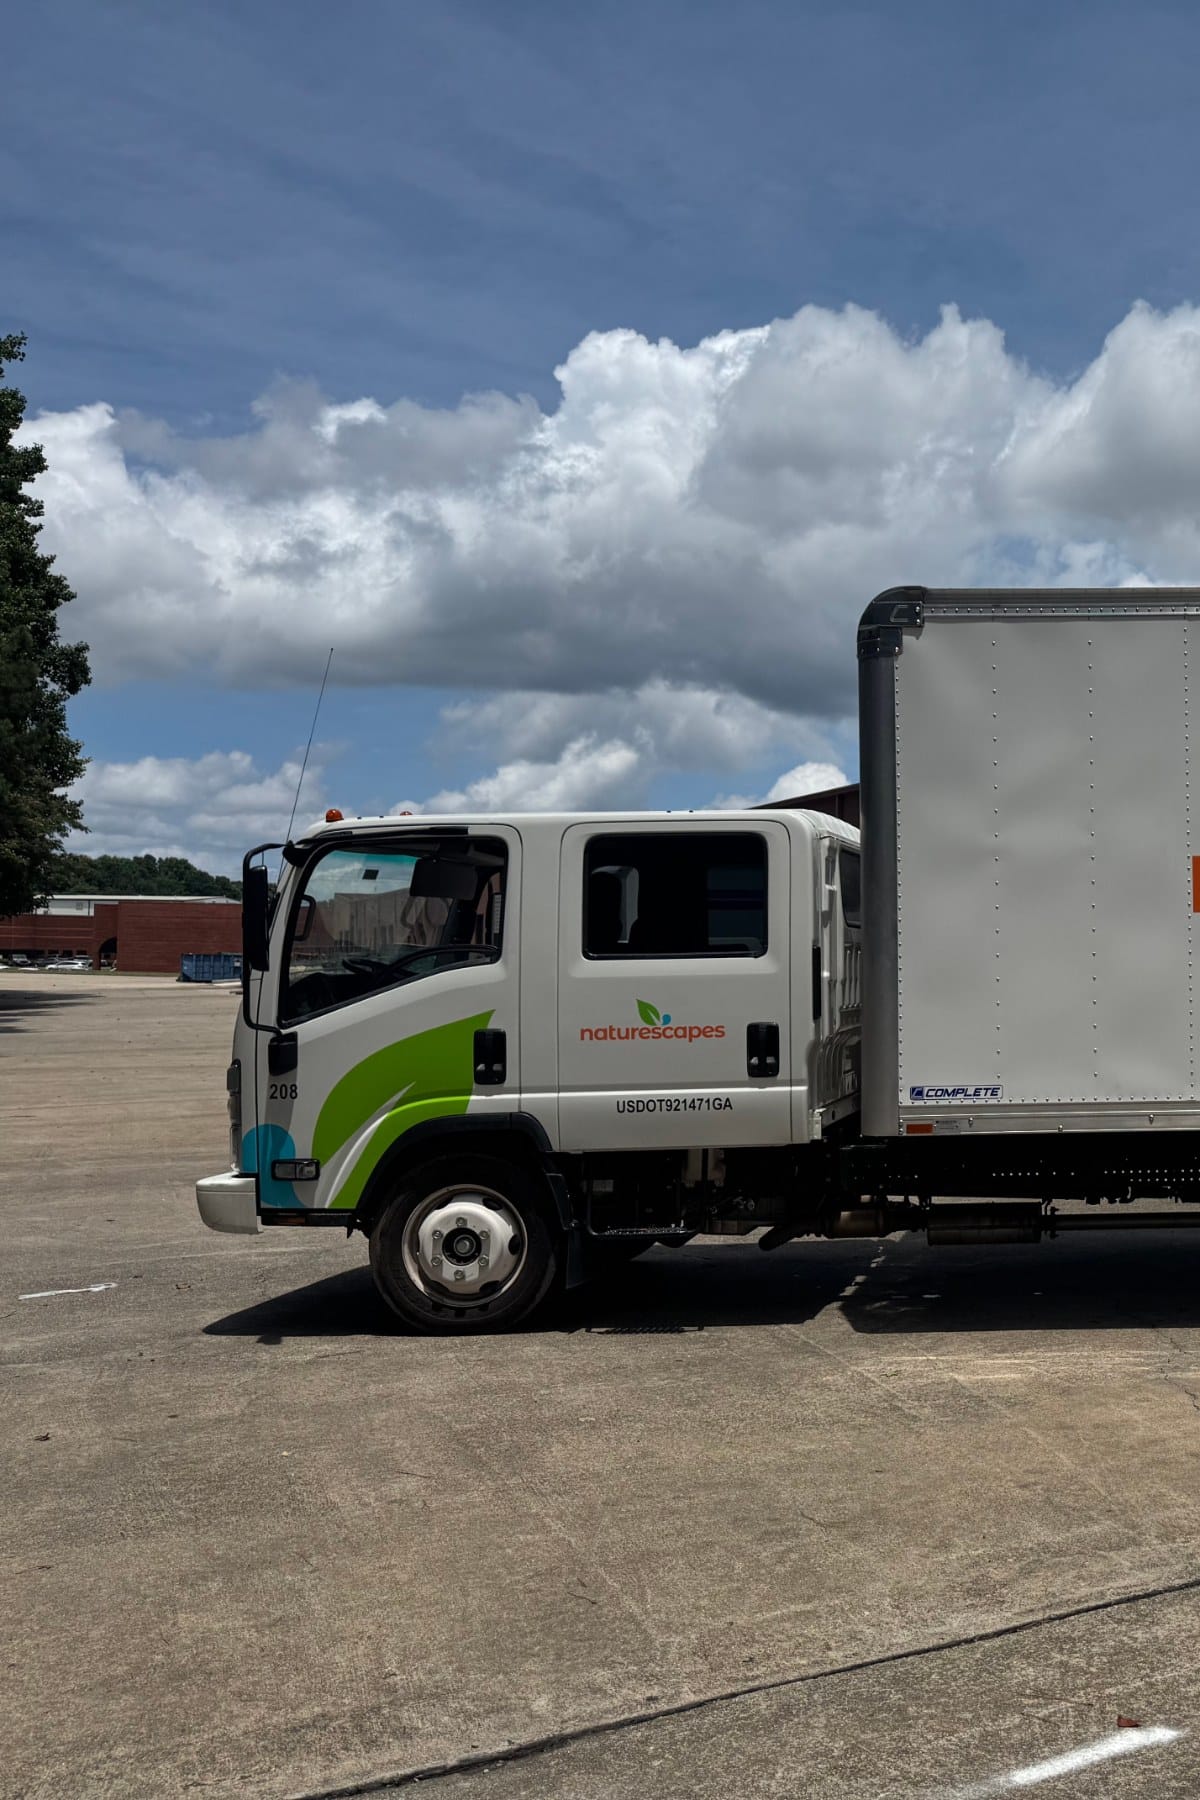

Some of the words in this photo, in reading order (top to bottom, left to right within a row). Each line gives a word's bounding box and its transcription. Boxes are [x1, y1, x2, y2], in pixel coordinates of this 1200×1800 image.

[580, 1024, 725, 1043] naturescapes
[269, 1083, 298, 1100] 208
[925, 1087, 1000, 1098] COMPLETE
[616, 1097, 733, 1113] USDOT921471GA
